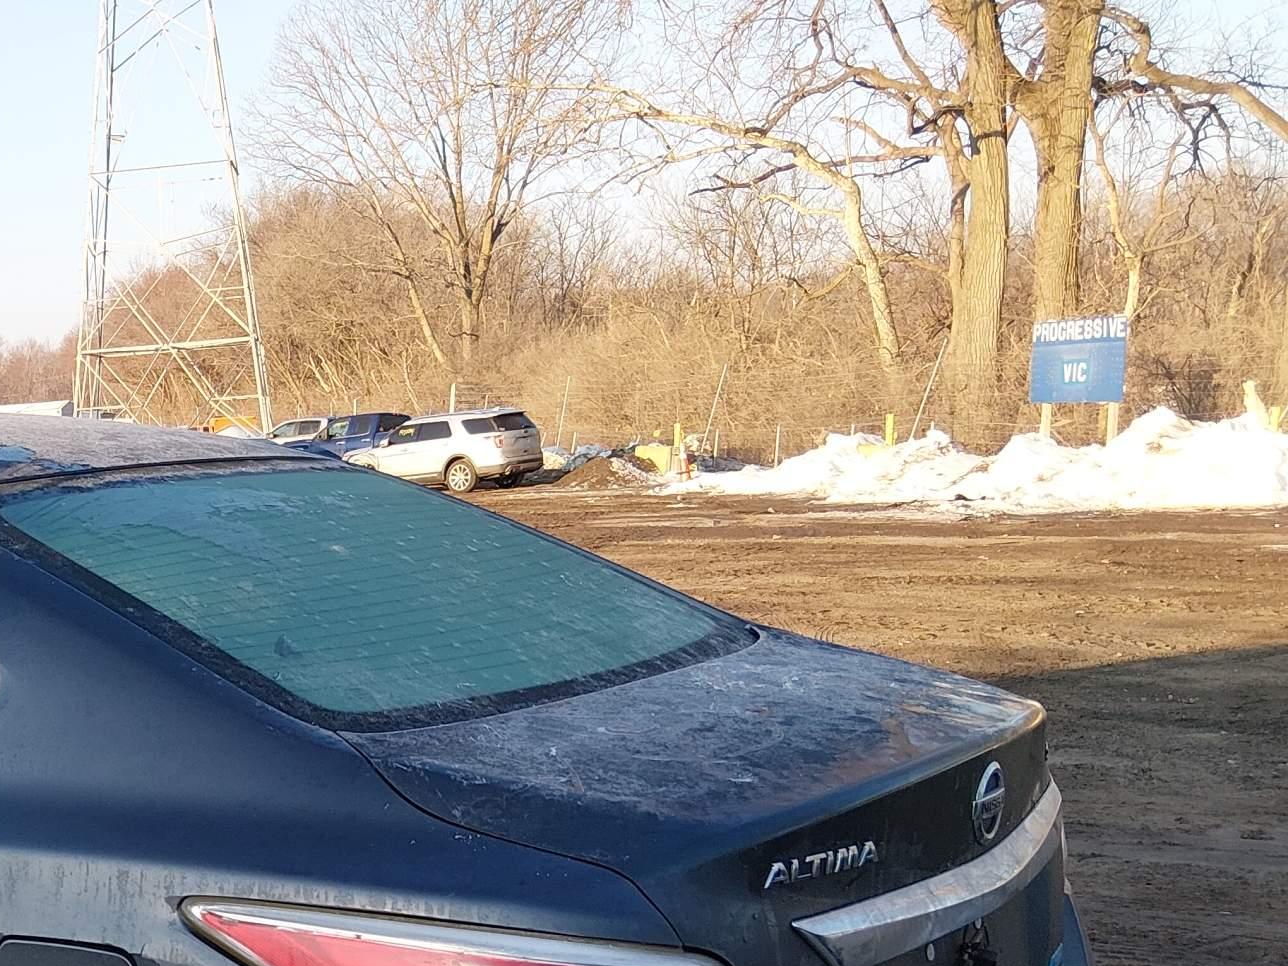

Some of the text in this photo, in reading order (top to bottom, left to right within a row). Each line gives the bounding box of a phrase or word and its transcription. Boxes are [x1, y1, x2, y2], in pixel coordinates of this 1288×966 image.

[1032, 316, 1127, 343] PROGRESSIVE
[1063, 361, 1088, 384] VIC
[764, 839, 879, 889] ALTIMA
